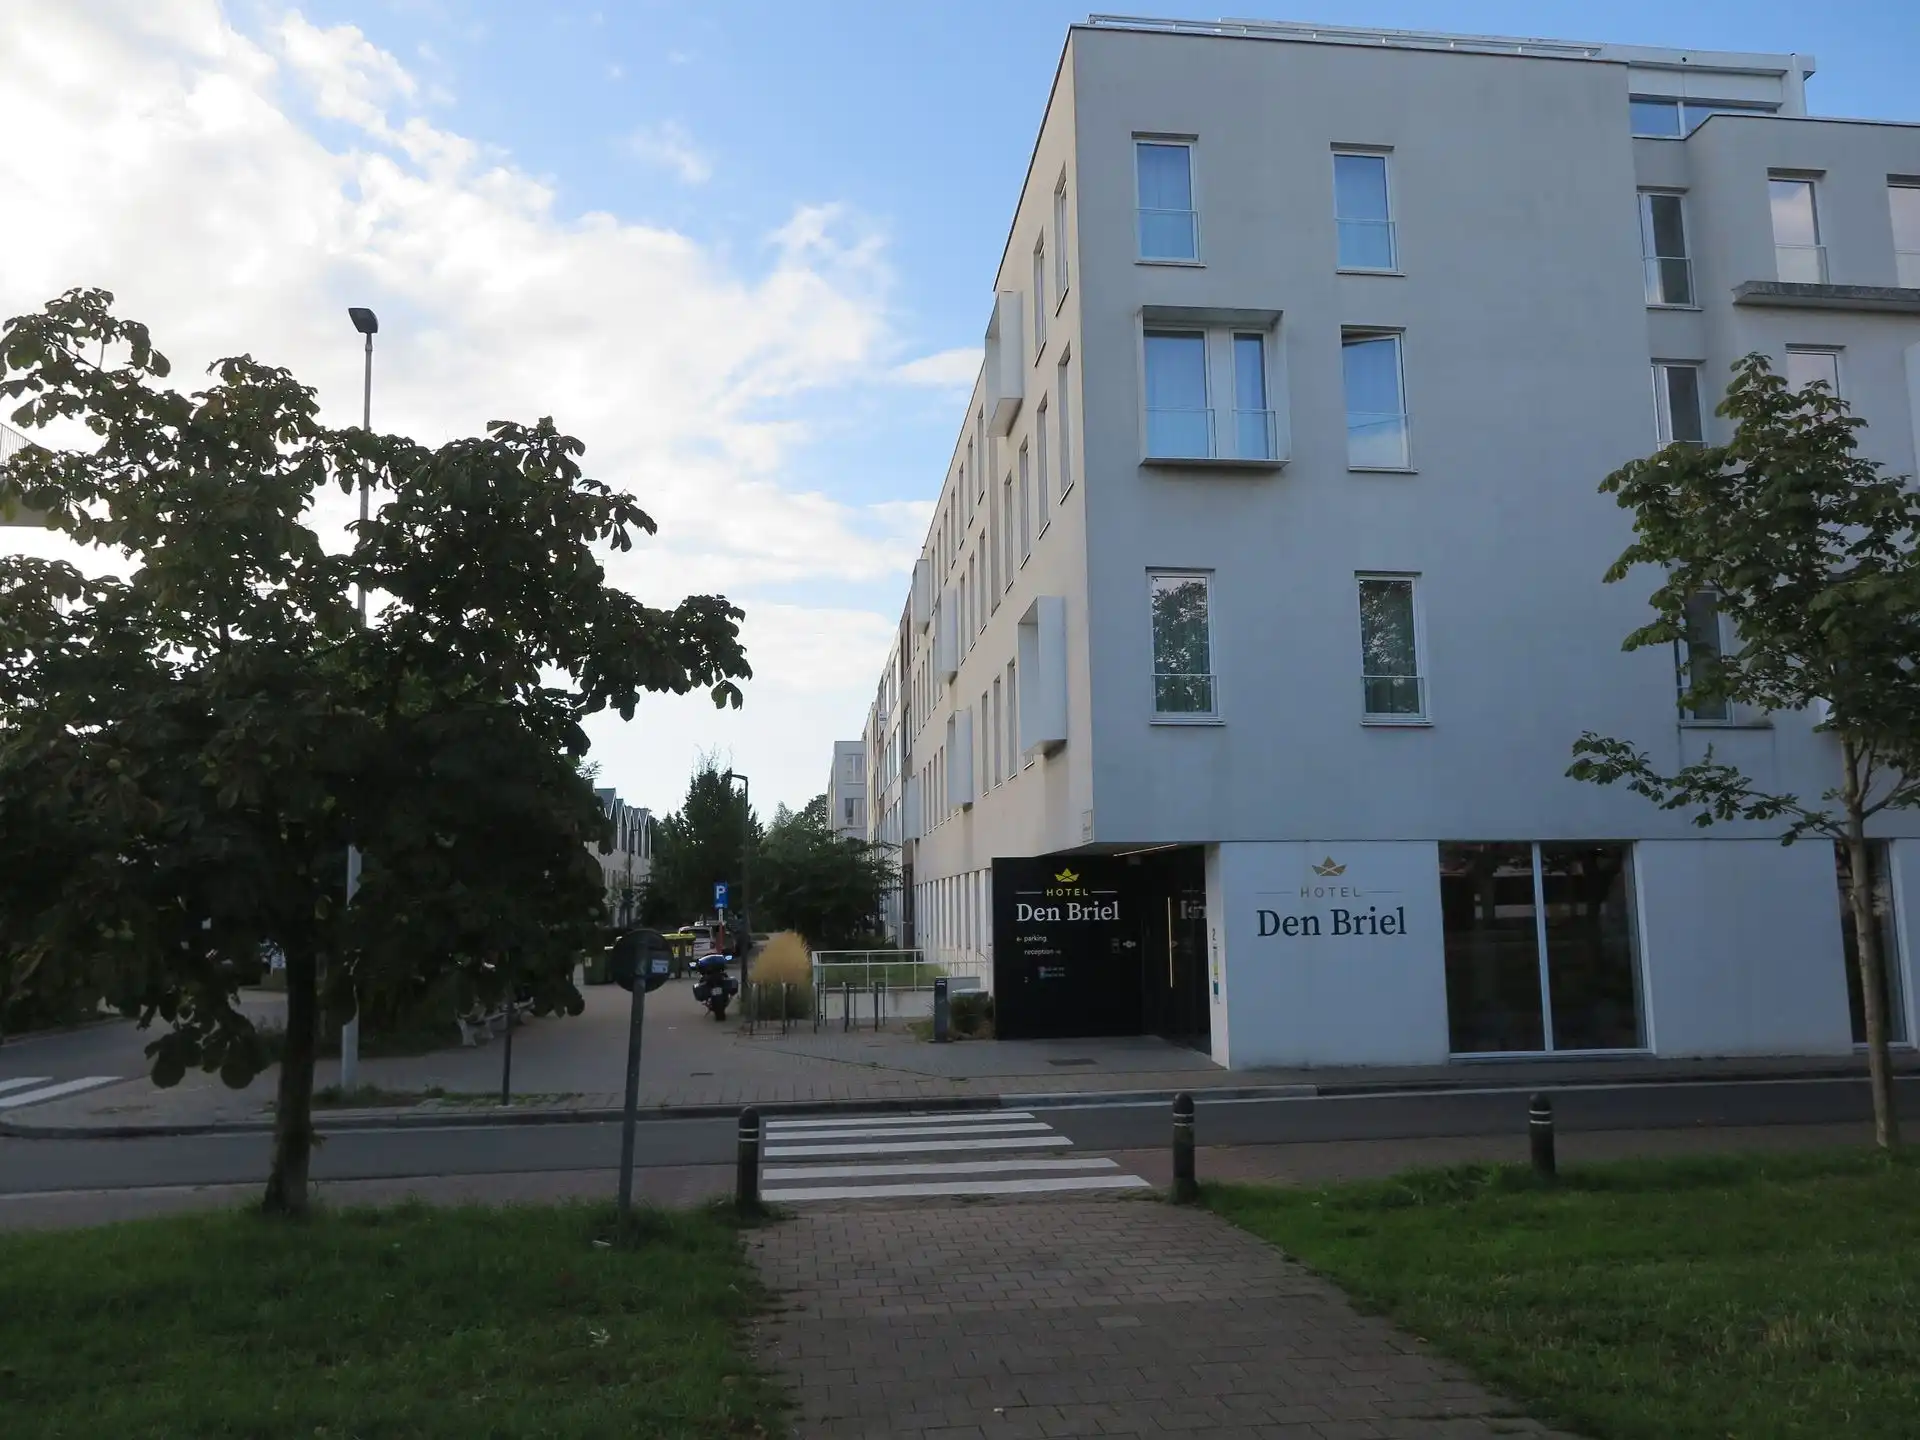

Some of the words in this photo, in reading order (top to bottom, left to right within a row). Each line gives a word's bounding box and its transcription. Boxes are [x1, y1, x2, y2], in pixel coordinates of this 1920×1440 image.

[716, 885, 726, 900] P
[1046, 888, 1089, 896] HOTEL
[1301, 887, 1361, 898] HOTEL
[1016, 903, 1061, 922] Den
[1067, 901, 1120, 921] Briel
[1257, 909, 1321, 937] Den
[1331, 906, 1407, 936] Briel
[1024, 934, 1047, 943] parking
[1024, 948, 1055, 957] reception
